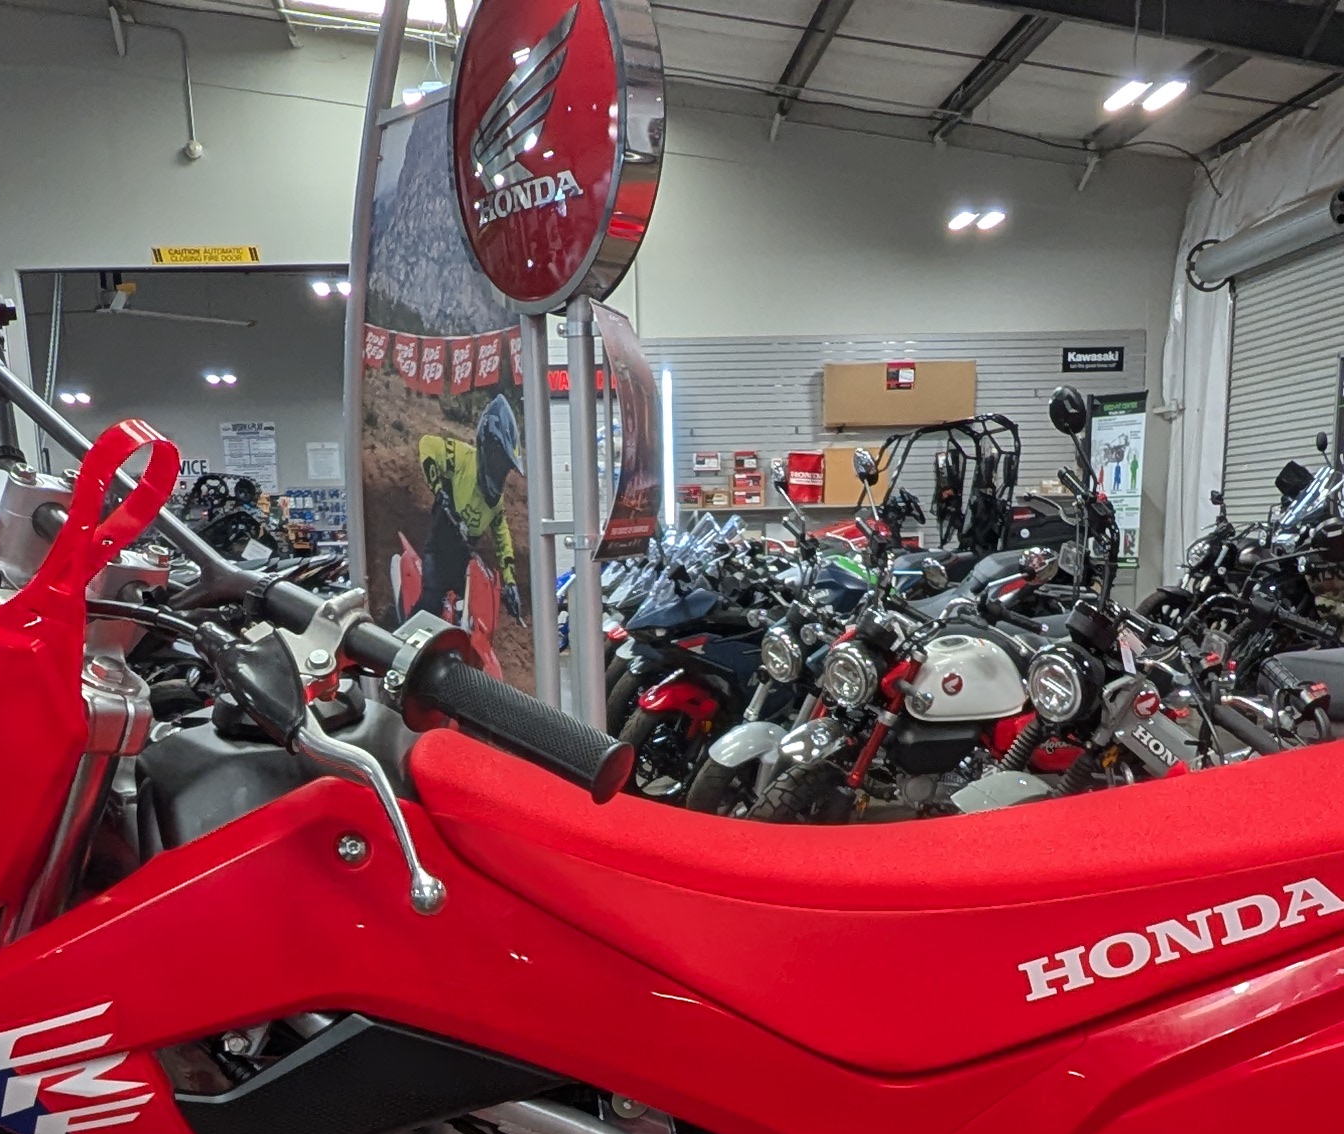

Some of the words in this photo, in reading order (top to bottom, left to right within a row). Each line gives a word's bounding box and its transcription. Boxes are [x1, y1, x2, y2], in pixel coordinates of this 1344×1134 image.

[474, 170, 584, 227] HONDA
[203, 247, 242, 255] AUTOMATIC
[221, 254, 242, 262] DOOR
[1067, 350, 1119, 362] Kawasaki
[180, 460, 207, 475] VICE
[1131, 724, 1179, 766] HON
